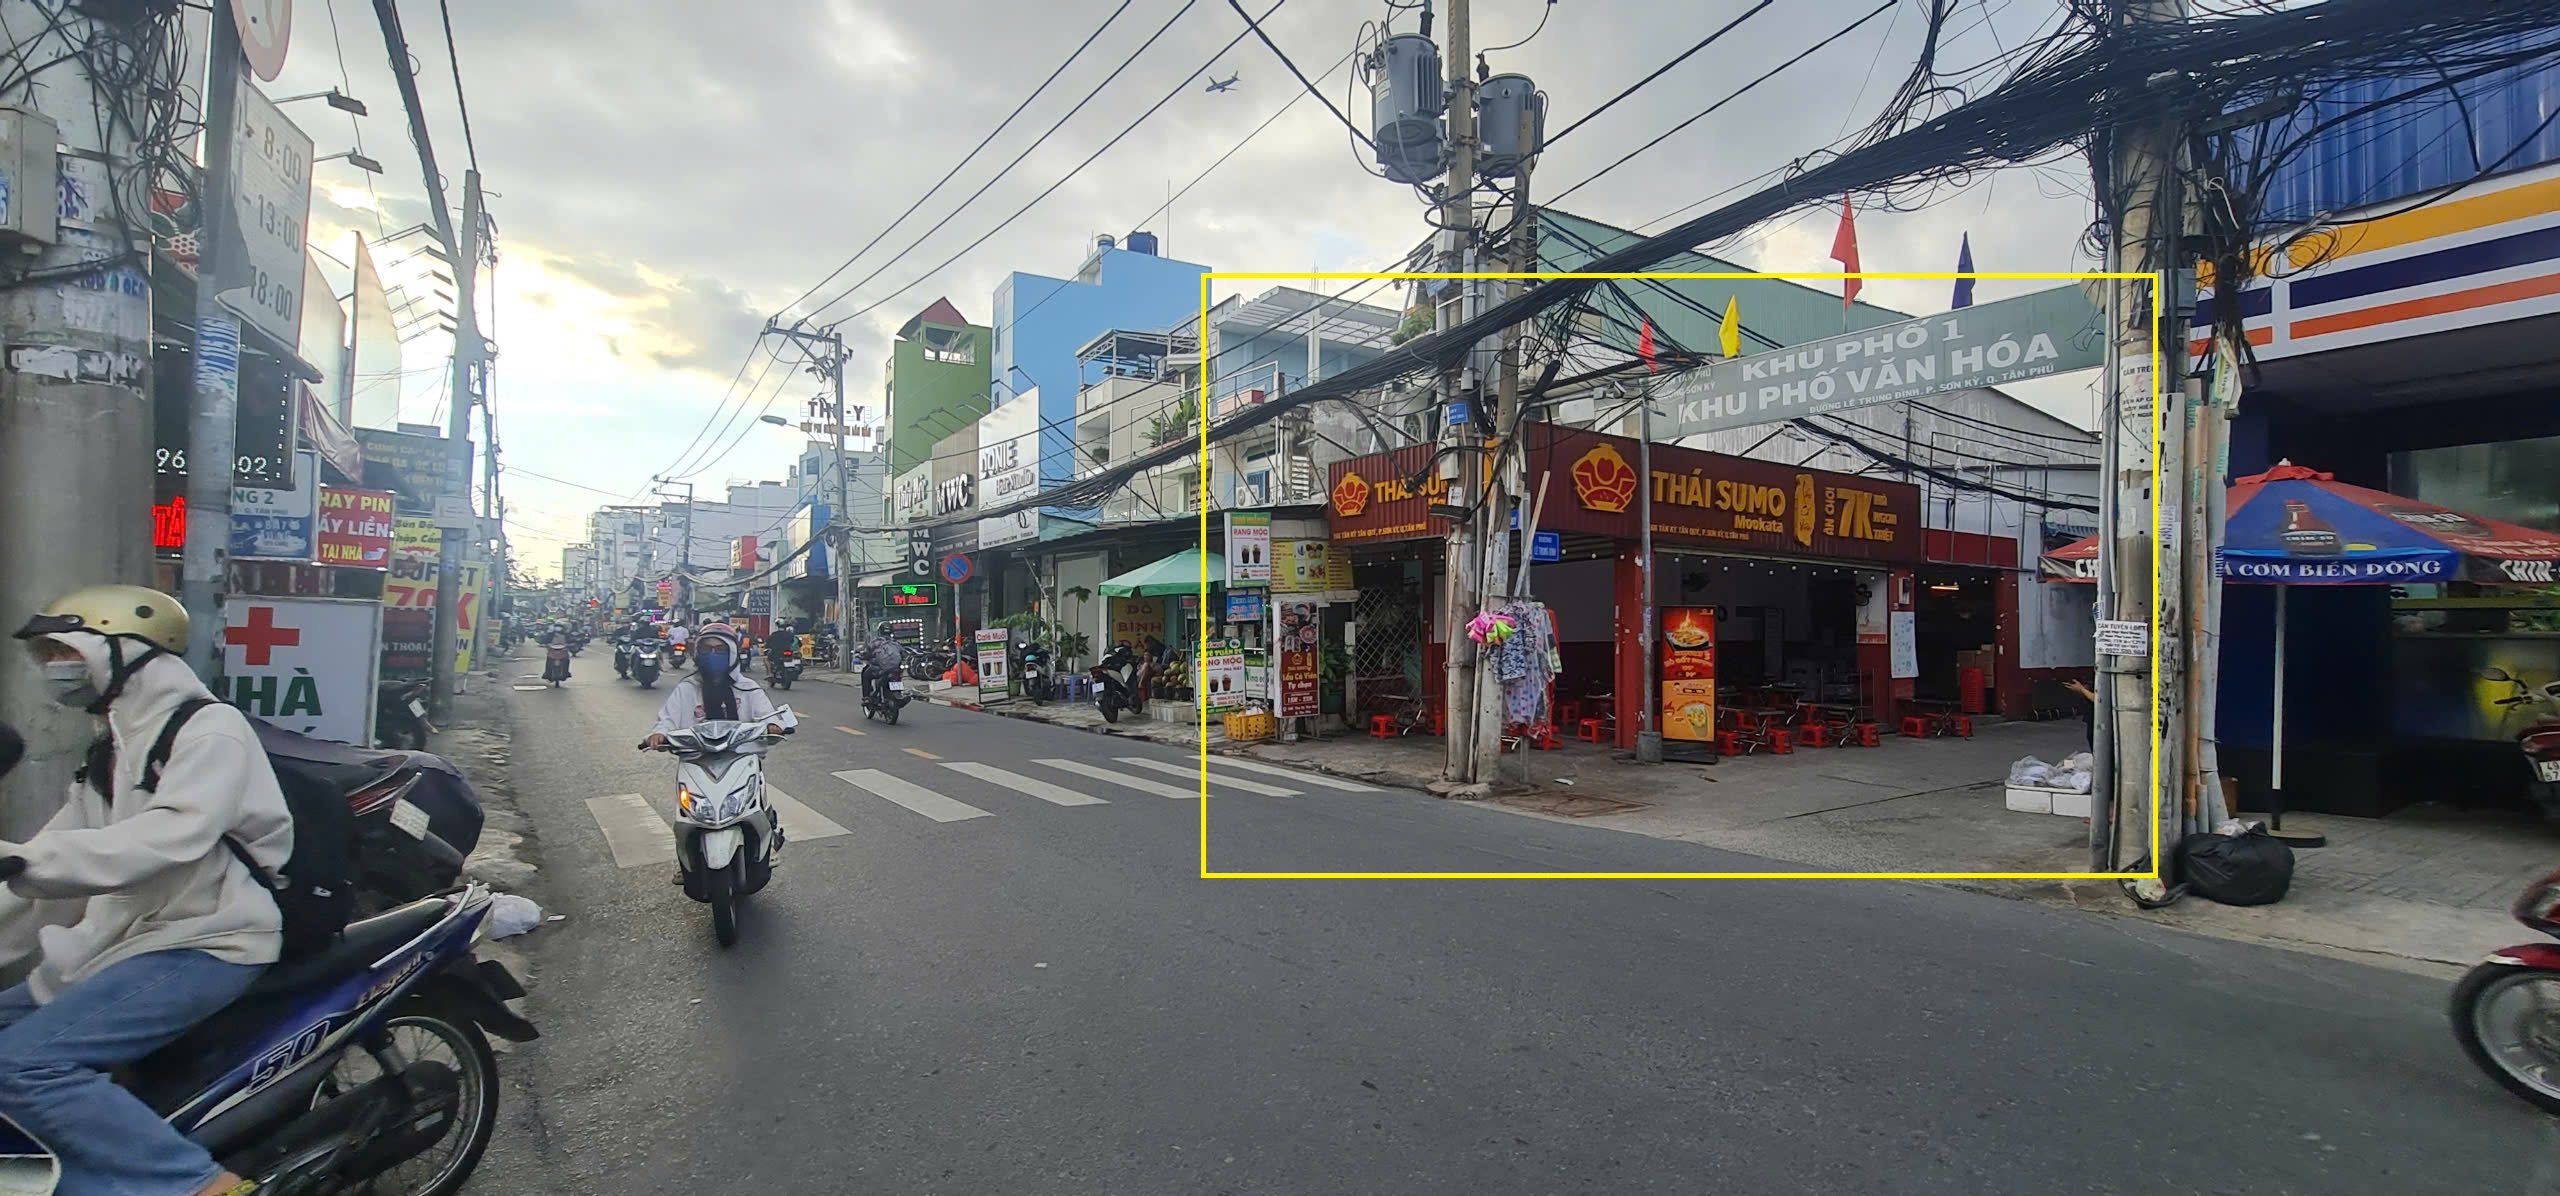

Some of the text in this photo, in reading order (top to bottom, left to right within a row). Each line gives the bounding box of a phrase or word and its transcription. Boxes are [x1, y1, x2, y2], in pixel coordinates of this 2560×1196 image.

[263, 127, 301, 185] 8:00
[258, 193, 299, 254] 13:00
[1742, 317, 1965, 382] KHU PHỐ 1
[1677, 332, 2060, 424] KHU PHỐ VĂN HÓA
[1859, 392, 1893, 405] TRUNG
[1938, 381, 1962, 393] SƠN
[2001, 369, 2026, 382] TÂN
[2028, 363, 2055, 378] PHÚ
[360, 495, 390, 513] PIN
[935, 472, 973, 516] MWC
[1651, 468, 1786, 517] THÁI SUMO
[1836, 487, 1873, 540] 7K
[347, 517, 389, 538] LIỀN
[1734, 515, 1784, 533] Mookata
[321, 541, 363, 562] TẠI NHÀ
[2238, 561, 2291, 577] CƠM
[2299, 560, 2357, 577] BIỂN
[2366, 560, 2441, 577] ĐÔNG
[2500, 559, 2560, 582] CHIN-
[1222, 656, 1243, 665] MỘC
[223, 667, 323, 717] HÀ
[249, 1019, 331, 1094] 50
